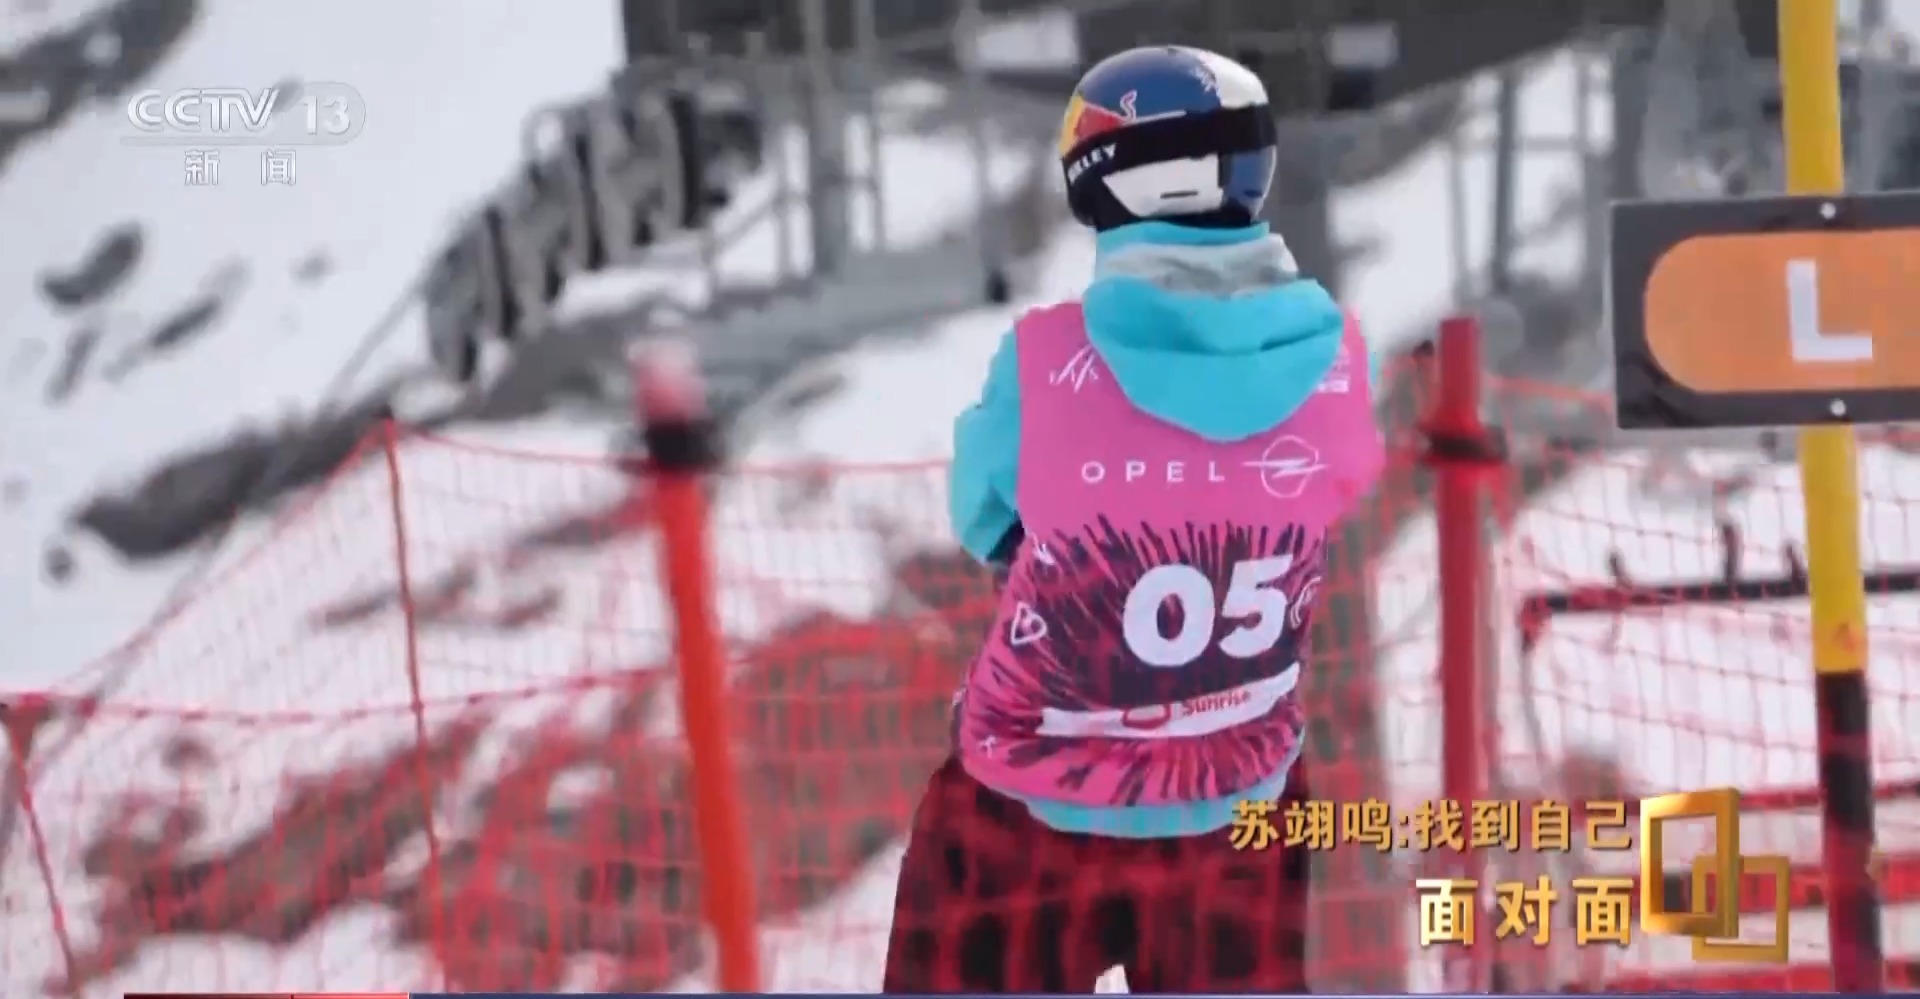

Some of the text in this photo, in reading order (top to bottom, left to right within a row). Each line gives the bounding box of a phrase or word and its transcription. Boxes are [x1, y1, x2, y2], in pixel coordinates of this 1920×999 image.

[1787, 259, 1873, 363] L
[1081, 461, 1226, 484] OPEL
[1123, 554, 1294, 667] 05
